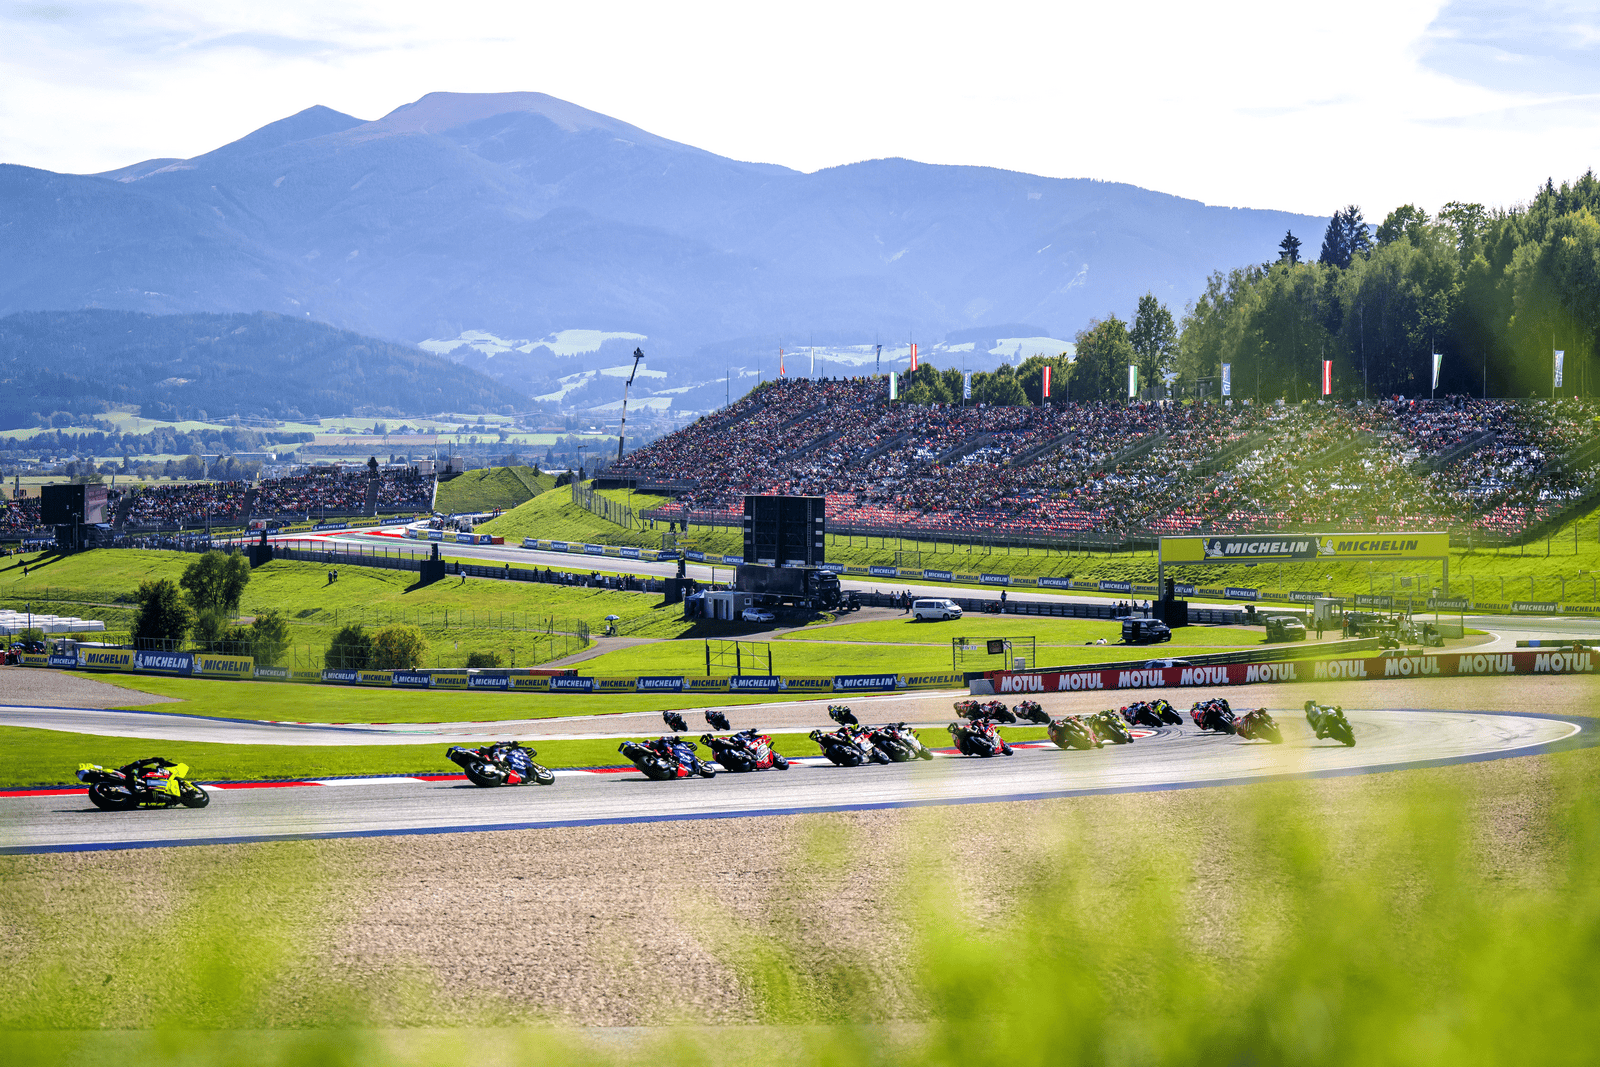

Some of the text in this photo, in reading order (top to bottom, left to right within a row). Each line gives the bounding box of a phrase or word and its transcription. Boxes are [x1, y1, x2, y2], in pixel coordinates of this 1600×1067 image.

[1225, 541, 1309, 554] MICHELIN
[1337, 540, 1418, 552] MICHELIN
[928, 571, 951, 579] MICHELIN
[984, 575, 1009, 583] MICHELIN
[1043, 578, 1068, 586] MICHELIN
[1074, 580, 1098, 588] MICHELIN
[1104, 582, 1130, 590] MICHELIN
[1230, 590, 1256, 598] MICHELIN
[1475, 602, 1509, 610] MICHELIN
[1519, 603, 1555, 612] MICHELIN
[25, 656, 48, 664] MICHELIN
[53, 658, 76, 666] MICHELIN
[87, 653, 130, 666] MICHELIN
[144, 656, 189, 669] MICHELIN
[1458, 654, 1516, 674] MOTUL
[1534, 652, 1593, 673] MOTUL
[203, 659, 251, 672] MICHELIN
[1313, 659, 1367, 680] MOTUL
[1385, 656, 1440, 677] MOTUL
[260, 669, 286, 677] MICHELIN
[293, 670, 320, 678] MICHELIN
[327, 672, 355, 680] MICHELIN
[1180, 666, 1230, 685] MOTUL
[1246, 662, 1297, 682] MOTUL
[363, 674, 391, 682] MICHELIN
[398, 675, 429, 684] MICHELIN
[436, 676, 467, 685] MICHELIN
[475, 678, 507, 686] MICHELIN
[843, 677, 894, 687] MICHELIN
[908, 674, 963, 685] MICHELIN
[1058, 672, 1104, 690] MOTUL
[1118, 669, 1166, 688] MOTUL
[557, 679, 592, 688] MICHELIN
[601, 680, 635, 688] MICHELIN
[644, 679, 681, 687] MICHELIN
[691, 679, 728, 687] MICHELIN
[738, 679, 777, 687] MICHELIN
[787, 679, 831, 687] MICHELIN
[1001, 675, 1045, 693] MOTUL
